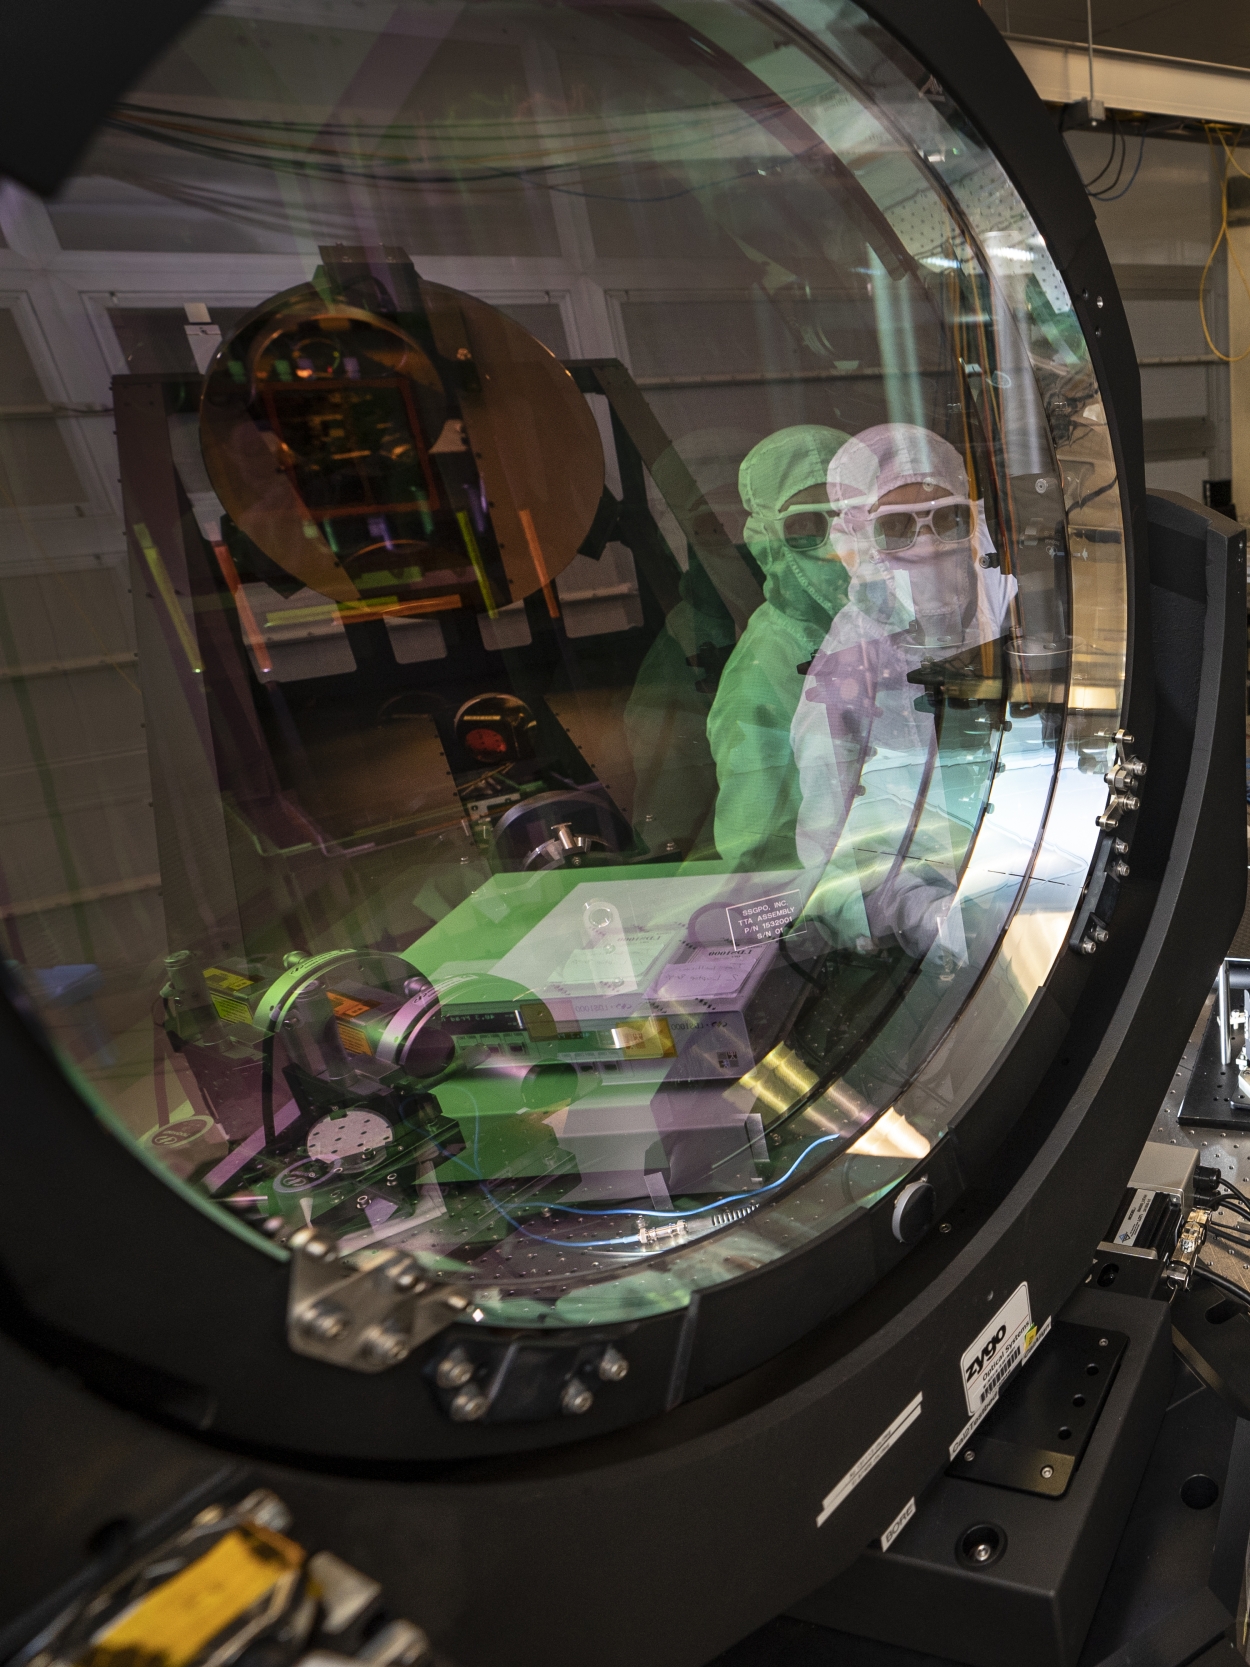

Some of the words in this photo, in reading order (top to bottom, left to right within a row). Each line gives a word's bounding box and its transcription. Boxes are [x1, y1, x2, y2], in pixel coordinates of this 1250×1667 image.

[773, 899, 789, 909] INC.
[738, 917, 753, 927] TTA
[757, 906, 795, 922] ASSEMBLY
[744, 925, 759, 934] P/N
[762, 916, 793, 929] 1532001
[756, 931, 772, 940] S/N
[966, 1324, 1007, 1384] zygo
[982, 1350, 1006, 1382] Optical
[1005, 1320, 1031, 1354] Systems
[885, 1505, 914, 1544] BORE
